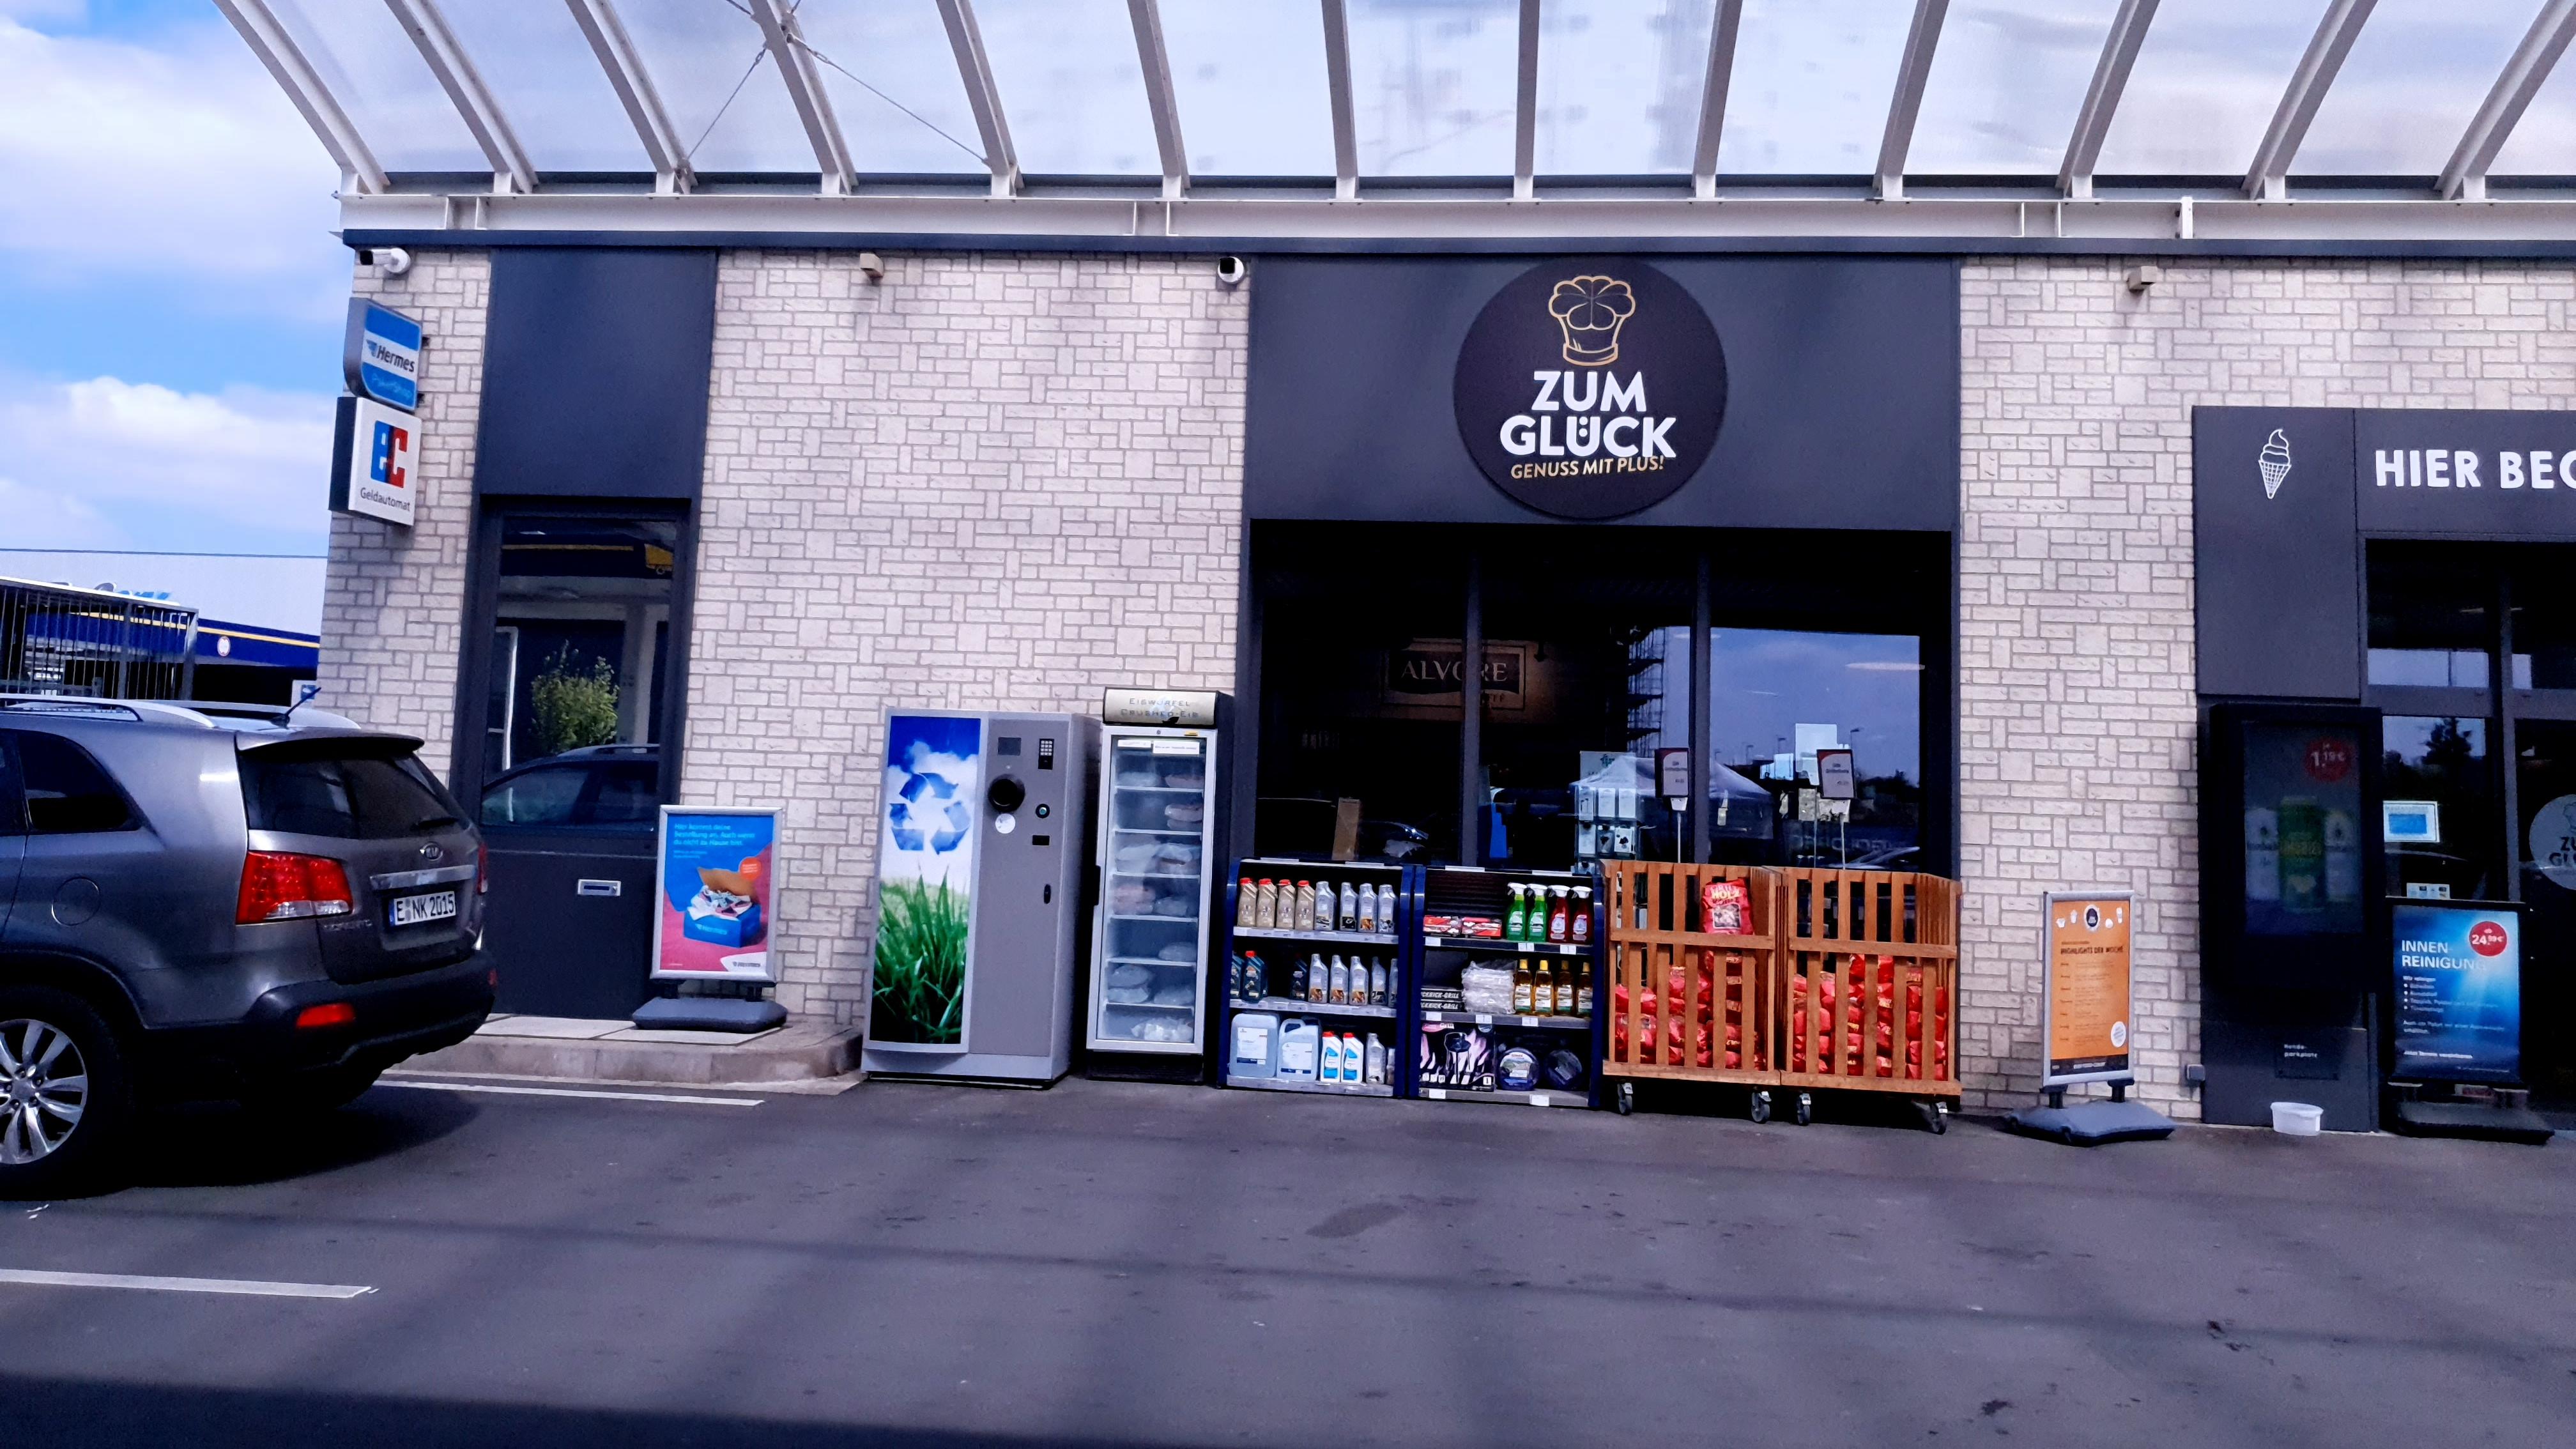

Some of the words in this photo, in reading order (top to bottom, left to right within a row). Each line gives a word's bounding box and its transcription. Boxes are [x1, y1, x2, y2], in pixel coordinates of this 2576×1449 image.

[376, 345, 415, 372] Hermes
[1531, 371, 1646, 412] ZUM
[1499, 415, 1677, 458] GLÜCK
[1510, 461, 1579, 479] GENUSS
[1583, 458, 1614, 475] MIT
[1617, 455, 1665, 473] PLUS!
[2375, 449, 2481, 488] HIER
[360, 487, 410, 512] Geldautomat
[397, 901, 405, 922] E
[412, 898, 428, 919] NK
[429, 893, 455, 917] 2015
[2402, 955, 2487, 970] REINIGUNG
